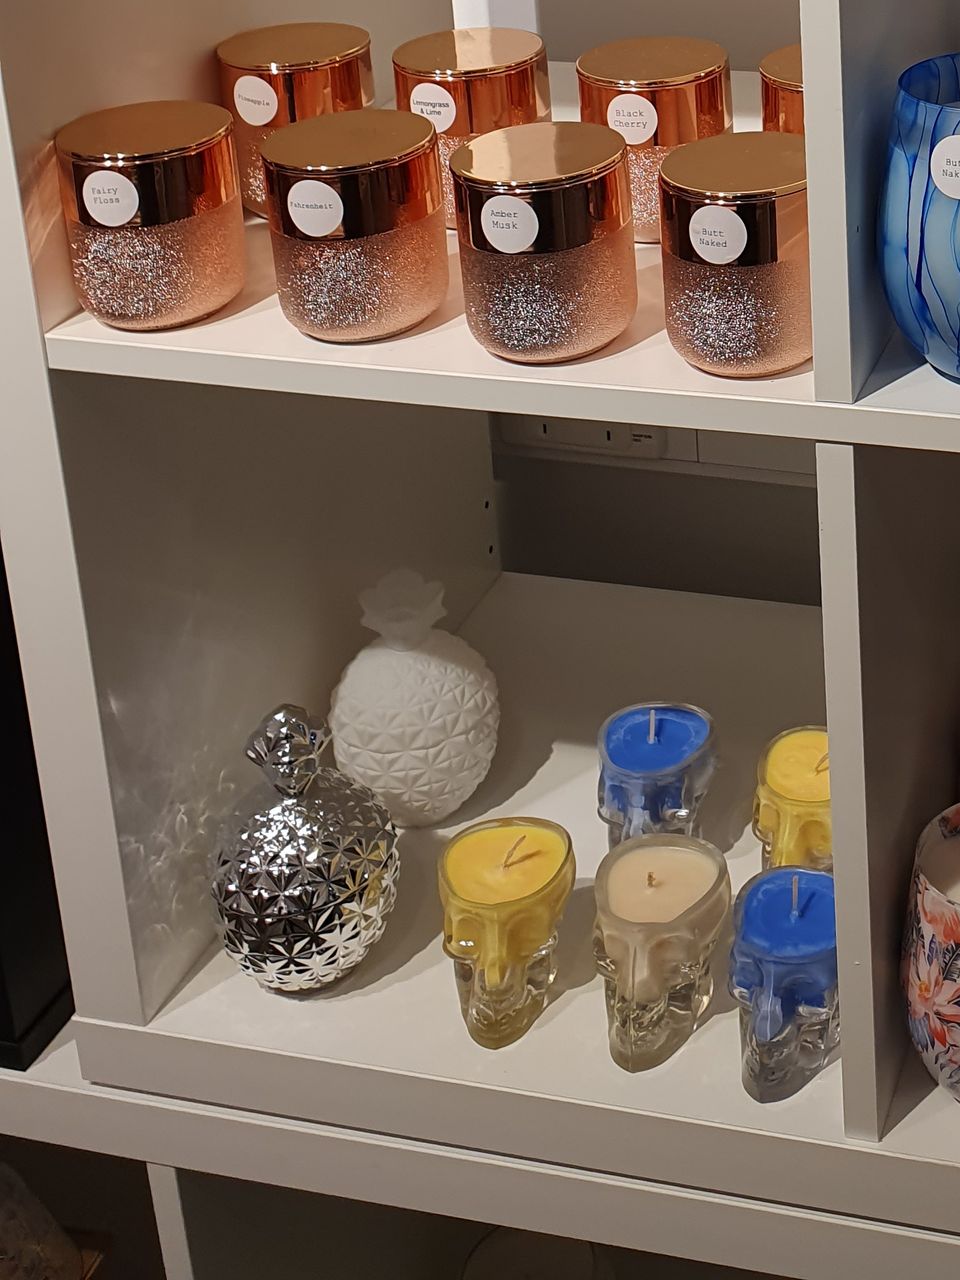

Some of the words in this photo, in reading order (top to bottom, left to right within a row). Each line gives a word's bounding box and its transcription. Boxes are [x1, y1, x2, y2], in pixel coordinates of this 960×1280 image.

[412, 99, 450, 109] Lemongrass
[615, 109, 645, 118] Black
[613, 119, 648, 129] Cherry
[91, 187, 118, 196] Fairy
[93, 196, 120, 205] Floss
[490, 209, 519, 218] Amber
[492, 220, 519, 230] Musk
[701, 227, 725, 238] Butt
[699, 237, 727, 248] Naked
